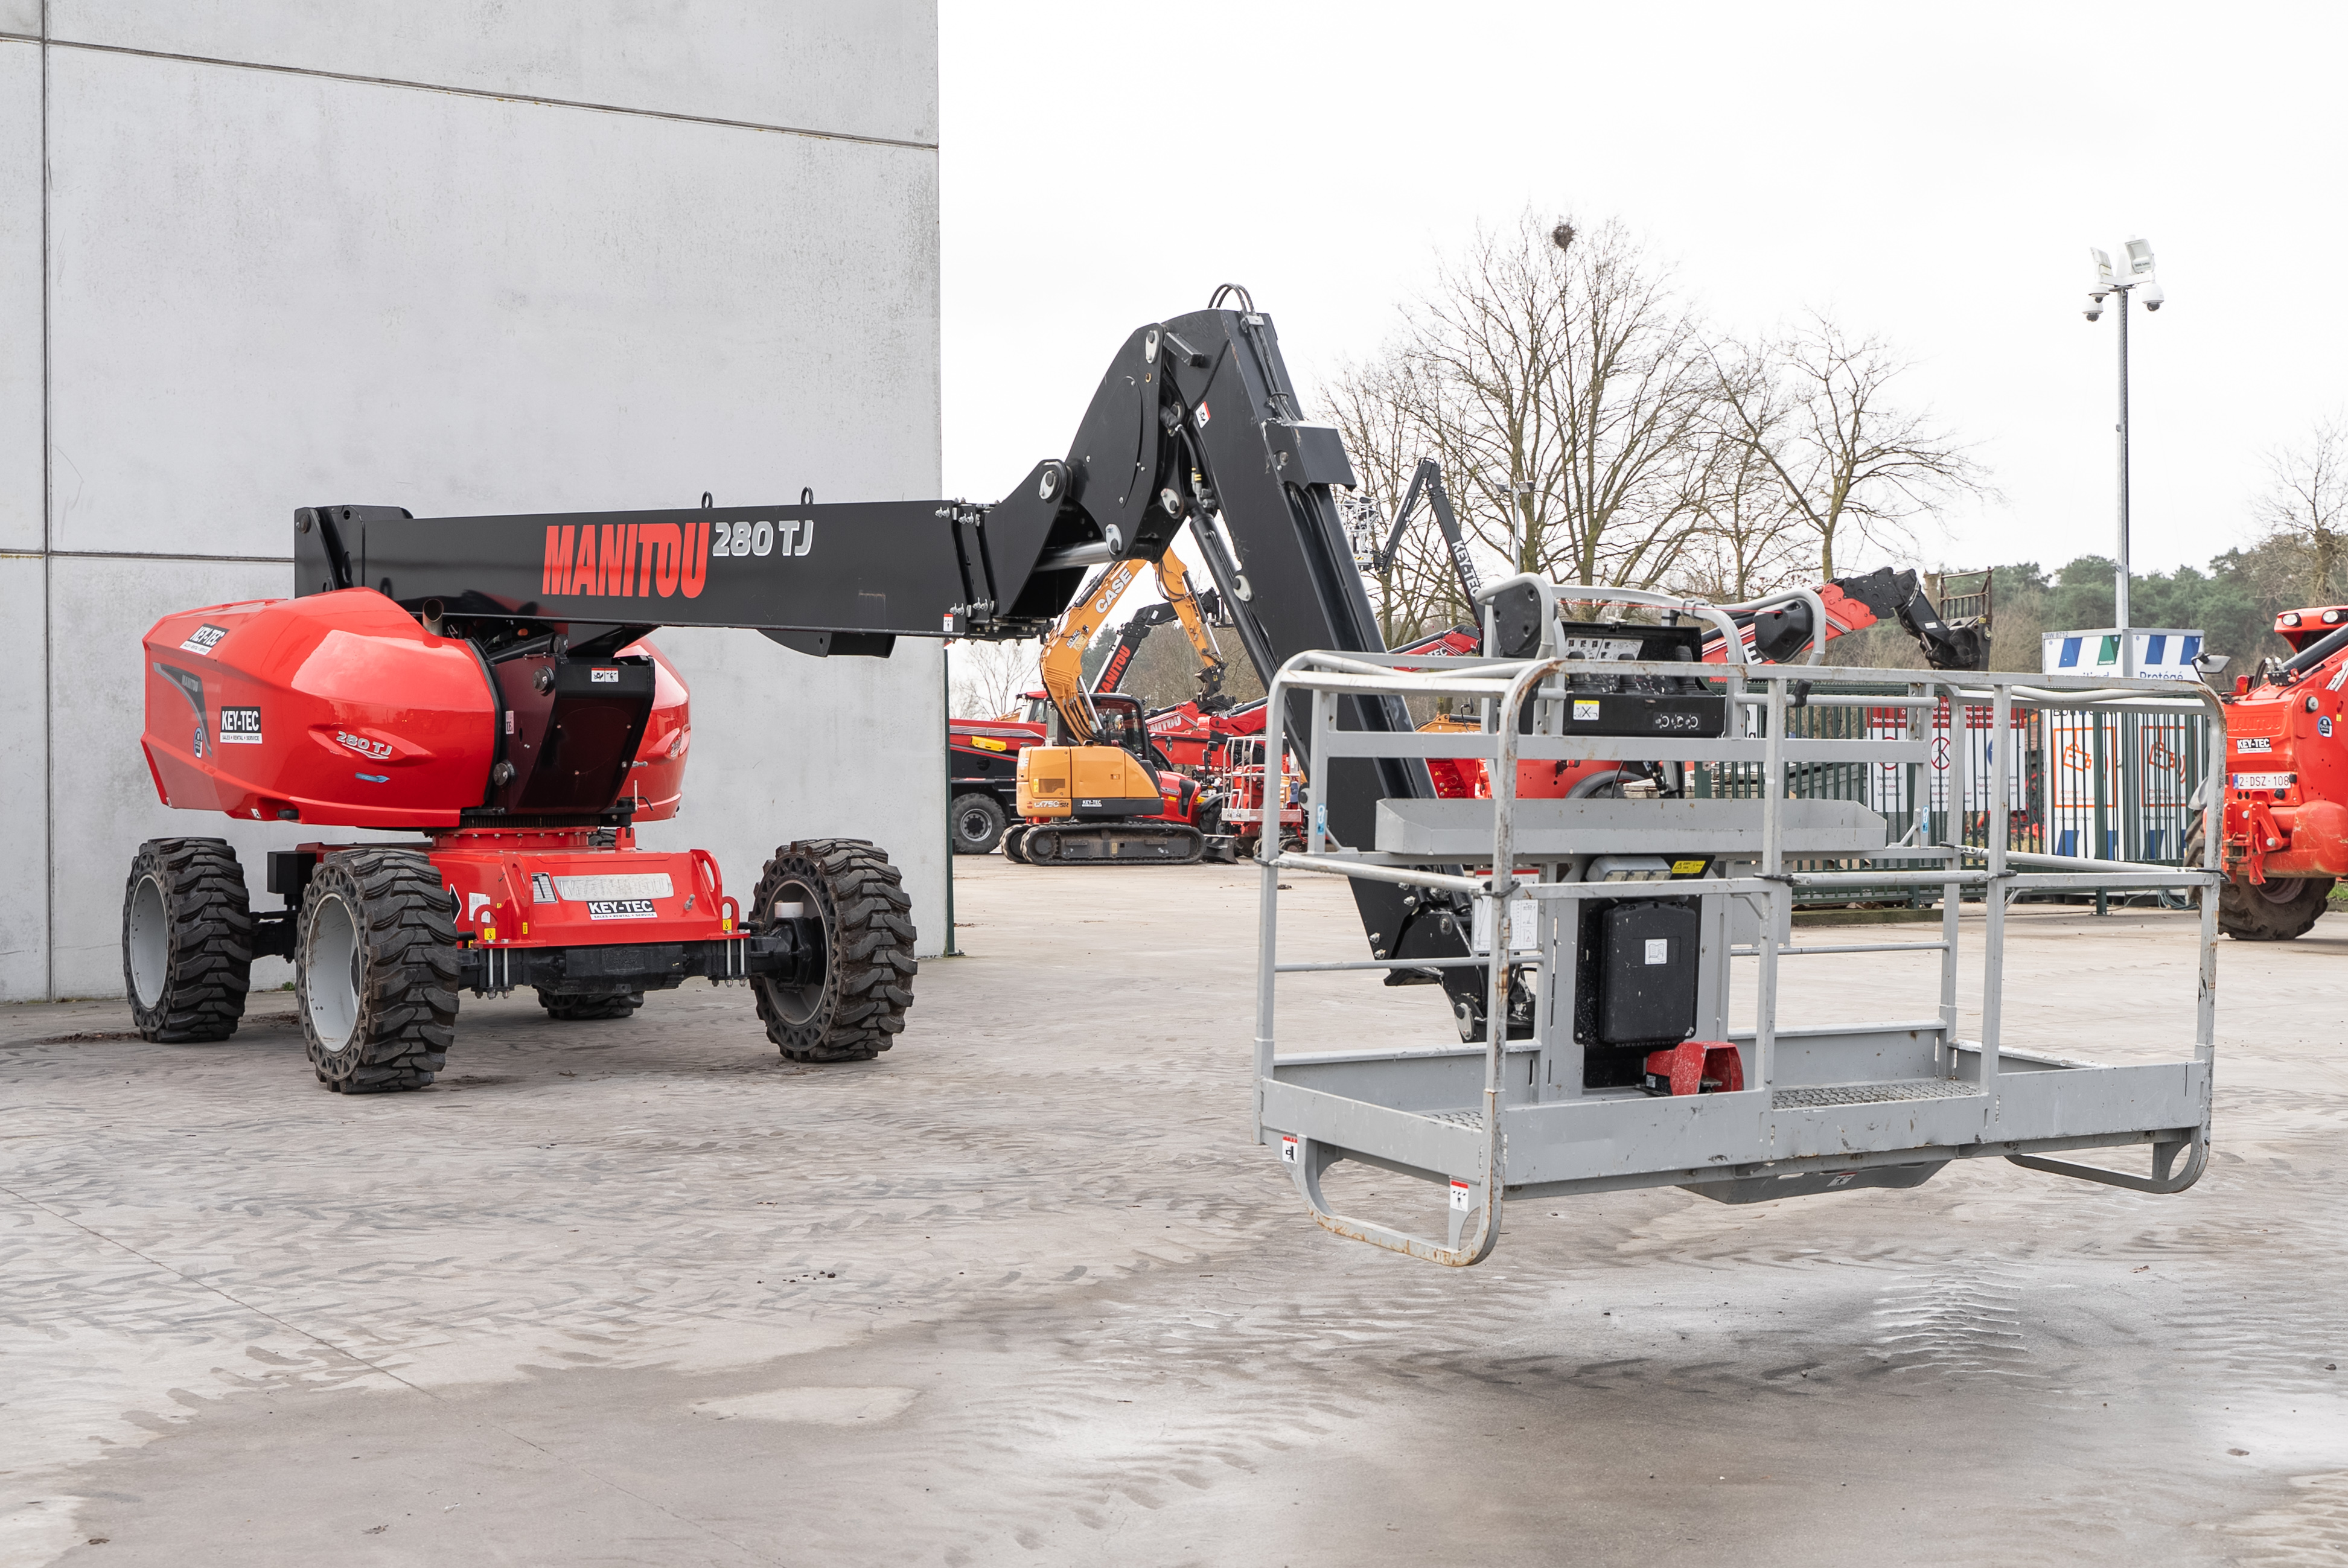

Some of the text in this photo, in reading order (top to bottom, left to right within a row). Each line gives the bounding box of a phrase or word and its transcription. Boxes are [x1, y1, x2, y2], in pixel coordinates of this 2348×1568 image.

[542, 520, 814, 598] MANITOU 280 TJ
[1452, 540, 1481, 598] KEY-TEC
[1096, 567, 1132, 613] CASE
[190, 626, 225, 646] KEY-TEC
[182, 674, 199, 692] MANITOU
[222, 710, 259, 731] KEY-TEC
[336, 730, 392, 756] 280 TJ
[2237, 738, 2270, 748] KEY-TEC
[560, 878, 670, 897] MANITOU
[588, 900, 652, 914] KEY-TEC
